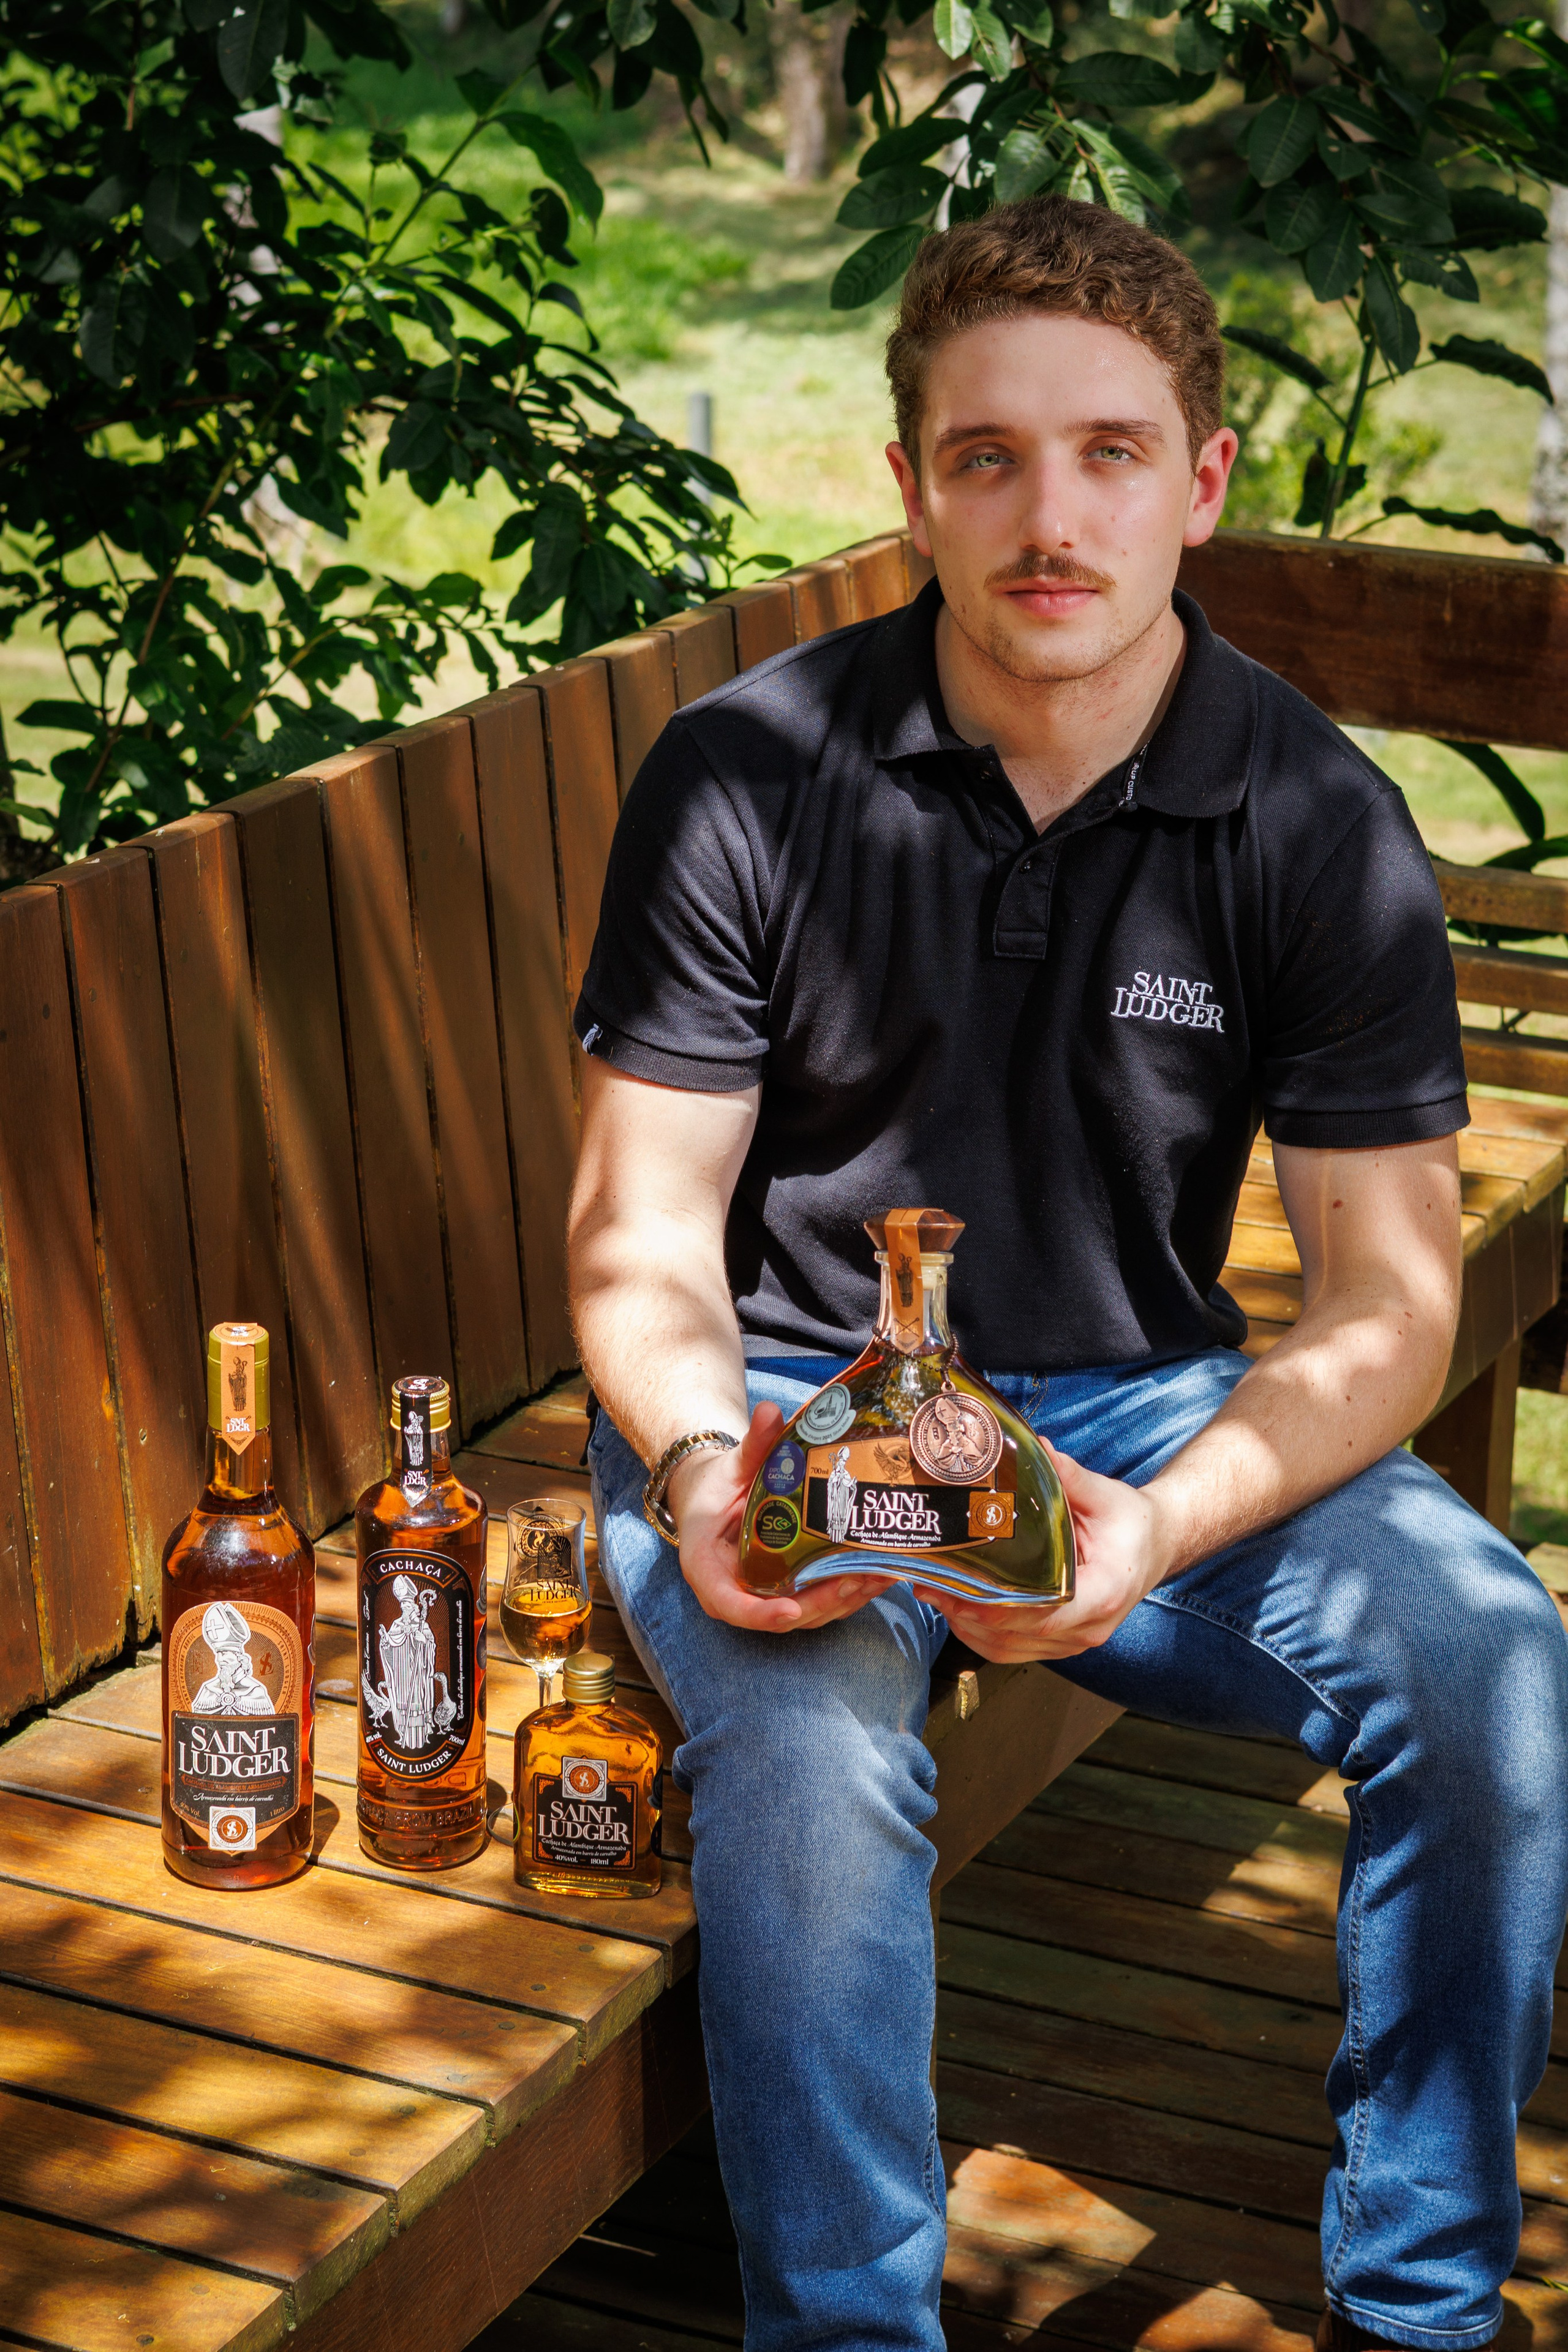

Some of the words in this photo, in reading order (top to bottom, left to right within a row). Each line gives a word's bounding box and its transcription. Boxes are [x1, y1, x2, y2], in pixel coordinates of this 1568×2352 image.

[1131, 770, 1137, 780] UP
[1133, 971, 1213, 1006] SAINT
[1110, 987, 1225, 1034] LUDGER
[227, 1423, 251, 1433] LDGR
[230, 1417, 246, 1426] SNT
[404, 1475, 427, 1486] LDGR
[407, 1470, 423, 1481] SNT
[864, 1490, 929, 1513] SAINT
[775, 1501, 797, 1524] CATARINENSE
[850, 1506, 942, 1535] LUDGER
[850, 1530, 872, 1540] Cachaça
[878, 1531, 908, 1542] Alambique
[380, 1560, 441, 1578] CACHAÇA
[537, 1579, 570, 1591] SAINT
[530, 1586, 578, 1602] LUDGER
[183, 1634, 196, 1649] BRASIL
[277, 1640, 289, 1660] SAINT
[192, 1725, 276, 1755] SAINT
[448, 1734, 466, 1746] 700ml
[178, 1740, 292, 1778] LUDGER
[377, 1748, 406, 1772] SAINT
[409, 1750, 451, 1773] LUDGER
[247, 1779, 282, 1790] ARMAZENADA
[193, 1792, 227, 1801] Armazenada
[190, 1807, 201, 1817] Vol.
[273, 1806, 285, 1815] litro
[395, 1811, 432, 1827] FROM
[435, 1804, 474, 1826] BRAZIL
[551, 1801, 617, 1824] SAINT
[538, 1813, 631, 1845] LUDGER
[541, 1837, 560, 1846] Cachaça
[567, 1841, 594, 1850] Alambique
[551, 1845, 576, 1855] Armazenada
